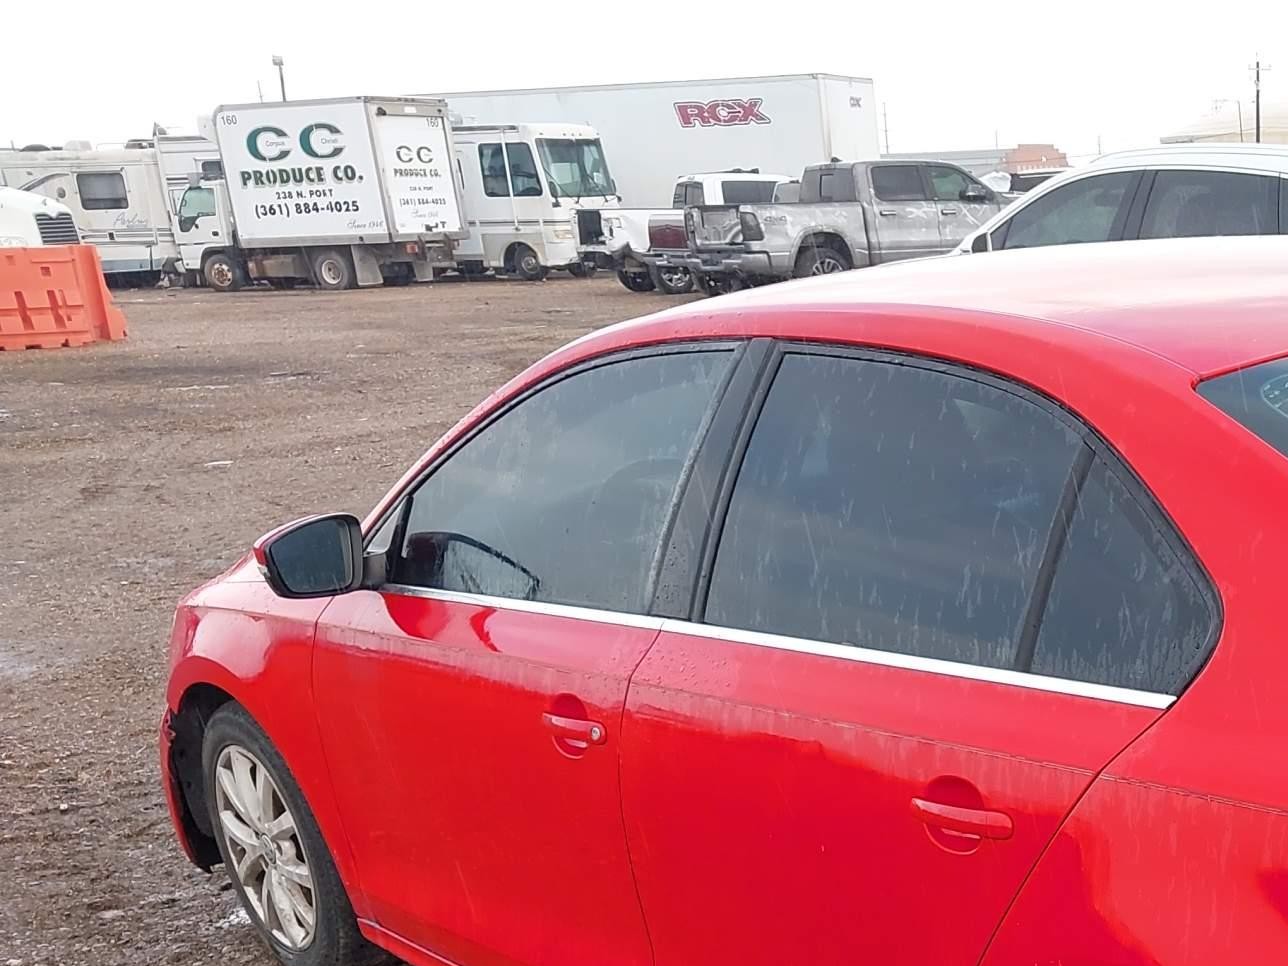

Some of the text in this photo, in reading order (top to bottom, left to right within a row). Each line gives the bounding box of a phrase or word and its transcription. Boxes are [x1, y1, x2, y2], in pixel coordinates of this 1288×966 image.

[221, 115, 238, 126] 160
[674, 98, 771, 128] RCX
[426, 116, 439, 128] 160
[240, 165, 364, 188] PRODUCE CO.
[275, 190, 293, 200] 238
[309, 188, 334, 199] PORT
[255, 200, 360, 219] (361) 884-4025
